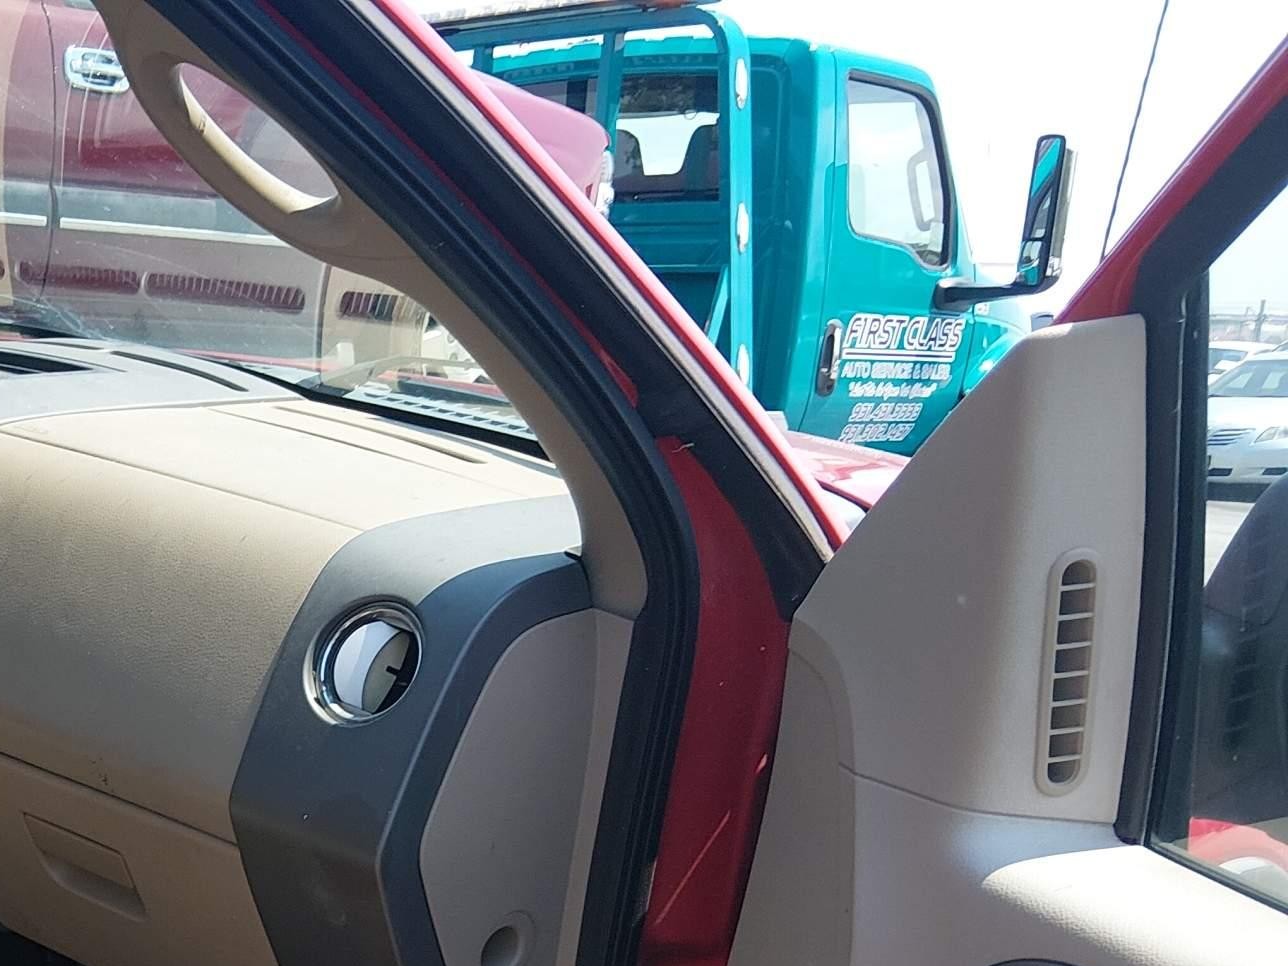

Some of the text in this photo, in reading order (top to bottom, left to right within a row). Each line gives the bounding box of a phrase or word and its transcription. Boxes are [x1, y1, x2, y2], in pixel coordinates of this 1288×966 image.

[844, 313, 966, 351] FIRST CLASS
[841, 361, 871, 378] AUTO
[872, 362, 913, 379] SERVICE
